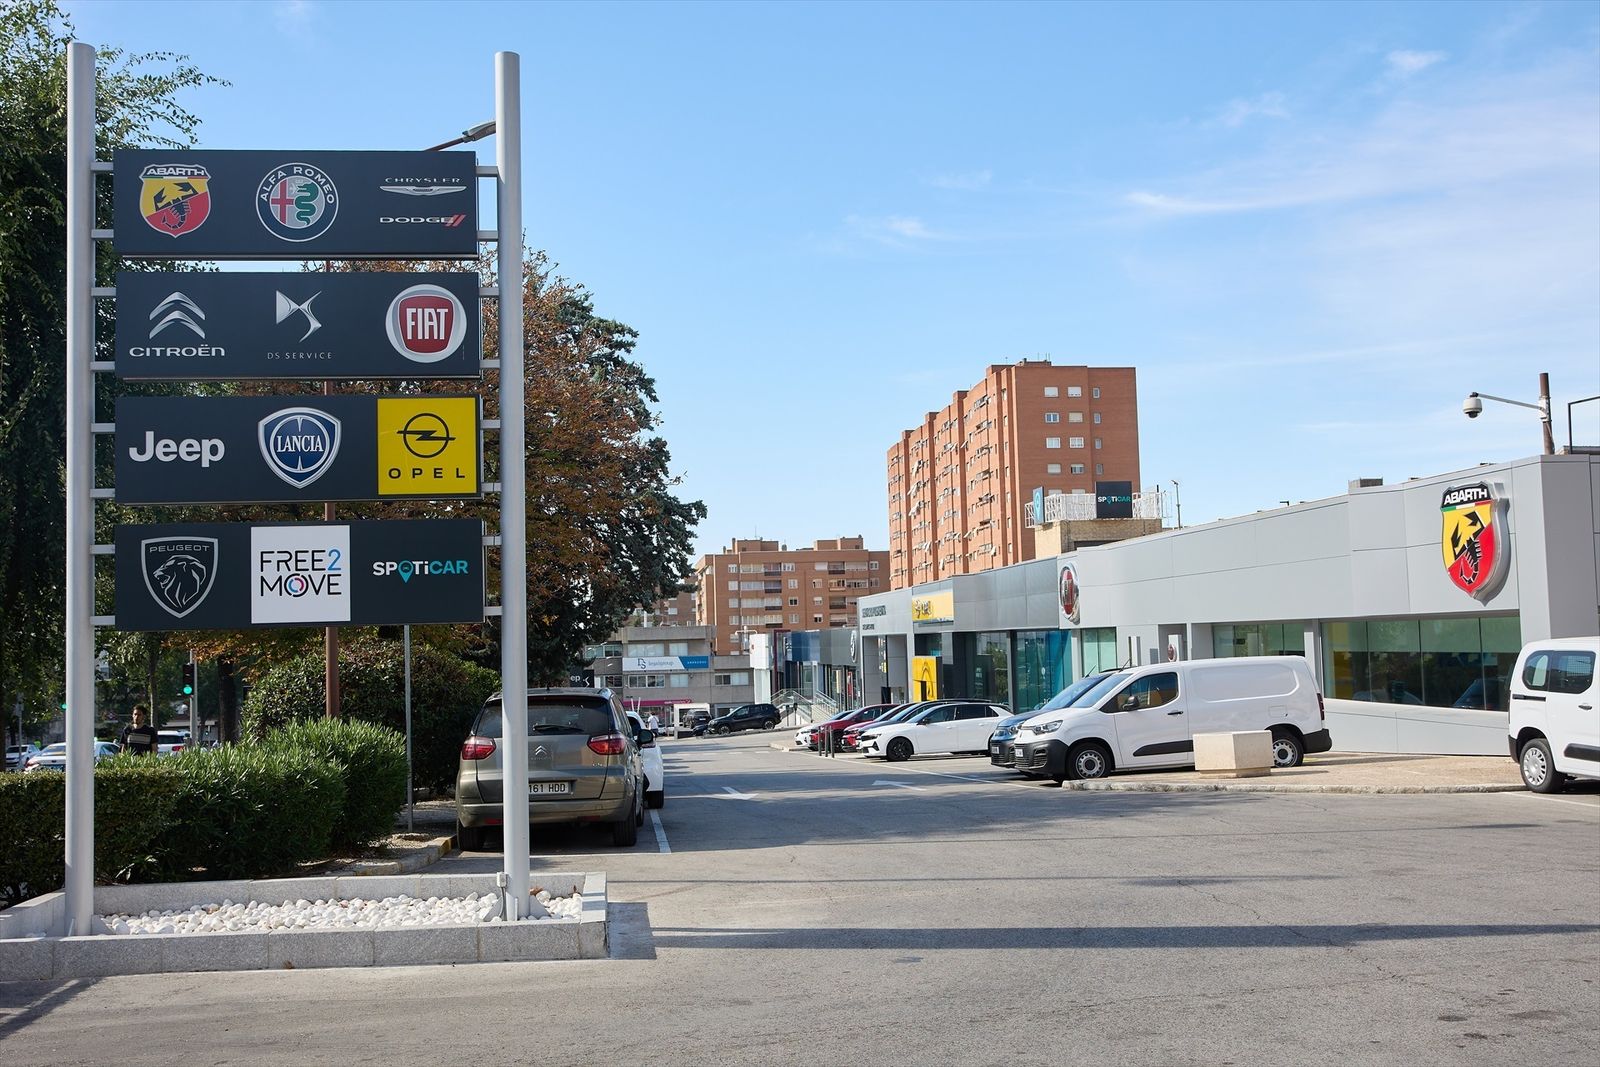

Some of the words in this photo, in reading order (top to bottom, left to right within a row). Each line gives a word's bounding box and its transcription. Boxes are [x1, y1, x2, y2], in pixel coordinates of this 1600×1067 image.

[147, 168, 204, 177] ABARTH
[260, 170, 287, 202] ALFA
[293, 166, 335, 204] ROMEO
[406, 307, 448, 340] FIAT
[267, 352, 280, 360] DS
[285, 352, 332, 360] SERVICE
[129, 431, 225, 468] Jeep
[276, 435, 324, 453] LANCIA
[388, 467, 466, 480] OPEL
[1443, 488, 1487, 505] ABARTH
[149, 545, 210, 553] PEUGEOT
[260, 549, 342, 573] FREE2
[260, 573, 342, 597] MOVE
[528, 784, 544, 793] 161
[548, 783, 566, 793] HDD
